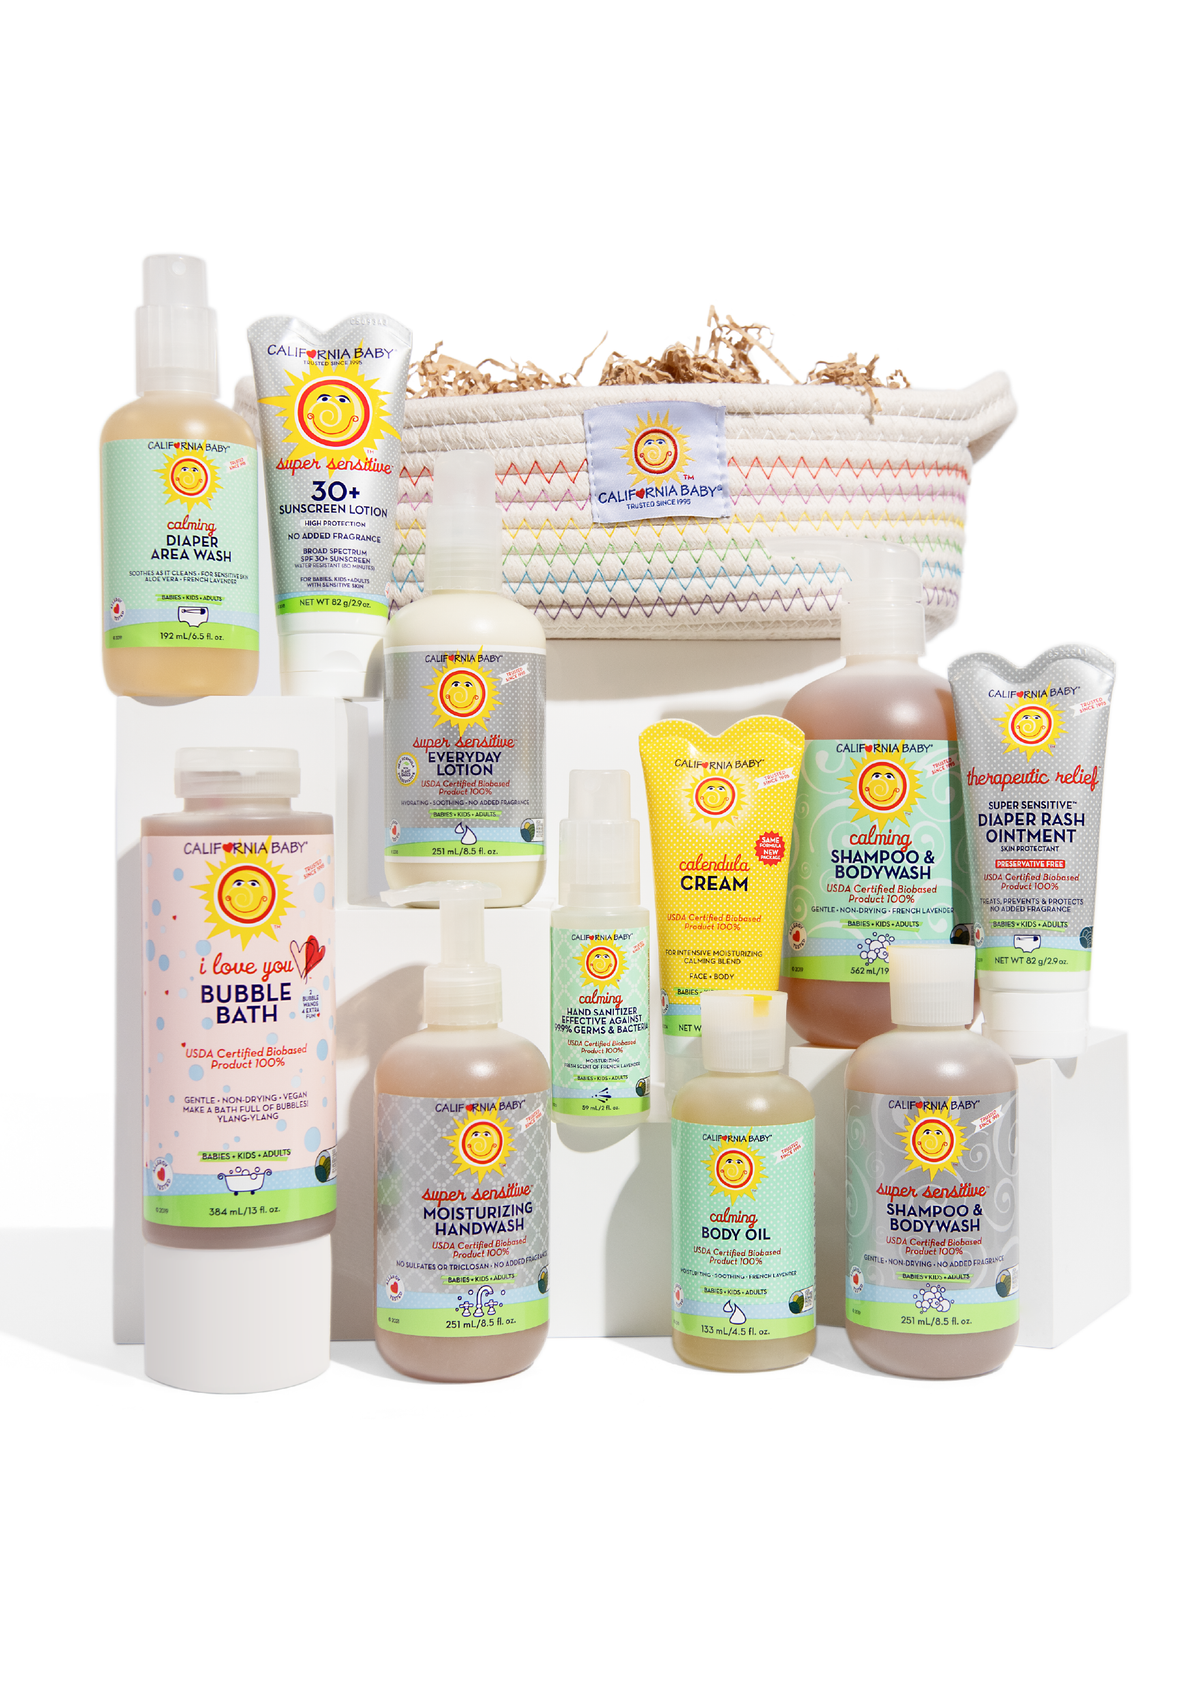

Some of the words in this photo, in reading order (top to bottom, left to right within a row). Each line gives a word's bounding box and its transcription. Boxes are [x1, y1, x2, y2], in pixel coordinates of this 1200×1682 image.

[276, 457, 321, 475] super
[311, 481, 360, 501] 30+
[279, 504, 346, 515] SUNSCREEN
[349, 505, 388, 517] LOTION
[626, 501, 655, 510] TRUSTED
[167, 514, 217, 537] calming
[167, 535, 218, 548] DIAPER
[332, 533, 381, 543] FRAGRANCE
[151, 549, 190, 560] AREA
[193, 550, 232, 562] WASH
[329, 548, 367, 556] SPECTRUM
[330, 556, 370, 564] SUNSCREEN
[332, 598, 341, 606] 82
[343, 598, 362, 608] g/2.9
[413, 737, 450, 752] super
[428, 752, 501, 762] EVERYDAY
[437, 764, 493, 776] LOTION
[764, 771, 786, 780] TRUSTED
[763, 778, 779, 786] SINCE
[967, 767, 1049, 791] therapeutic
[1056, 764, 1100, 791] relief
[988, 801, 1019, 810] SUPER
[978, 812, 1038, 827] DIAPER
[1041, 812, 1085, 826] RASH
[849, 825, 912, 852] calming
[986, 829, 1077, 843] OINTMENT
[447, 847, 477, 856] mL/8.5
[831, 850, 919, 863] SHAMPOO
[925, 851, 935, 863] &
[679, 853, 750, 872] calendula
[1046, 860, 1064, 868] FREE
[835, 866, 931, 879] BODYWASH
[680, 876, 749, 891] CREAM
[827, 885, 851, 893] USDA
[854, 885, 896, 894] Certified
[897, 885, 937, 893] Biobased
[849, 895, 884, 904] Product
[886, 895, 915, 903] 100%
[199, 957, 207, 975] i
[213, 952, 257, 975] love
[262, 960, 294, 982] you
[201, 982, 292, 1003] BUBBLE
[579, 989, 623, 1009] calming
[216, 1004, 278, 1024] BATH
[567, 1007, 591, 1015] HAND
[593, 1006, 637, 1016] SANITIZER
[561, 1017, 607, 1025] EFFECTIVE
[610, 1015, 642, 1025] AGAINST
[574, 1026, 606, 1034] GERMS
[617, 1023, 648, 1033] BACTERIA
[186, 1048, 213, 1058] USDA
[217, 1047, 264, 1060] Certified
[266, 1043, 308, 1057] Biobased
[211, 1059, 252, 1069] Product
[255, 1058, 285, 1068] 100%
[184, 1096, 215, 1104] GENTLE
[222, 1094, 277, 1103] NON-DRYING
[283, 1091, 308, 1100] VEGAN
[276, 1100, 308, 1111] BUBBLES!
[217, 1113, 279, 1122] YLANG-YLANG
[202, 1152, 231, 1160] BABIES
[263, 1149, 291, 1158] ADULTS
[422, 1188, 466, 1207] super
[876, 1183, 918, 1202] super
[209, 1208, 227, 1216] 384
[229, 1207, 257, 1216] mL/13
[423, 1202, 533, 1220] MOISTURIZING
[887, 1203, 969, 1217] SHAMPOO
[973, 1204, 983, 1215] &
[710, 1207, 758, 1228] calming
[435, 1218, 524, 1235] HANDWASH
[890, 1218, 980, 1232] BODYWASH
[702, 1227, 740, 1240] BODY
[745, 1228, 770, 1240] OIL
